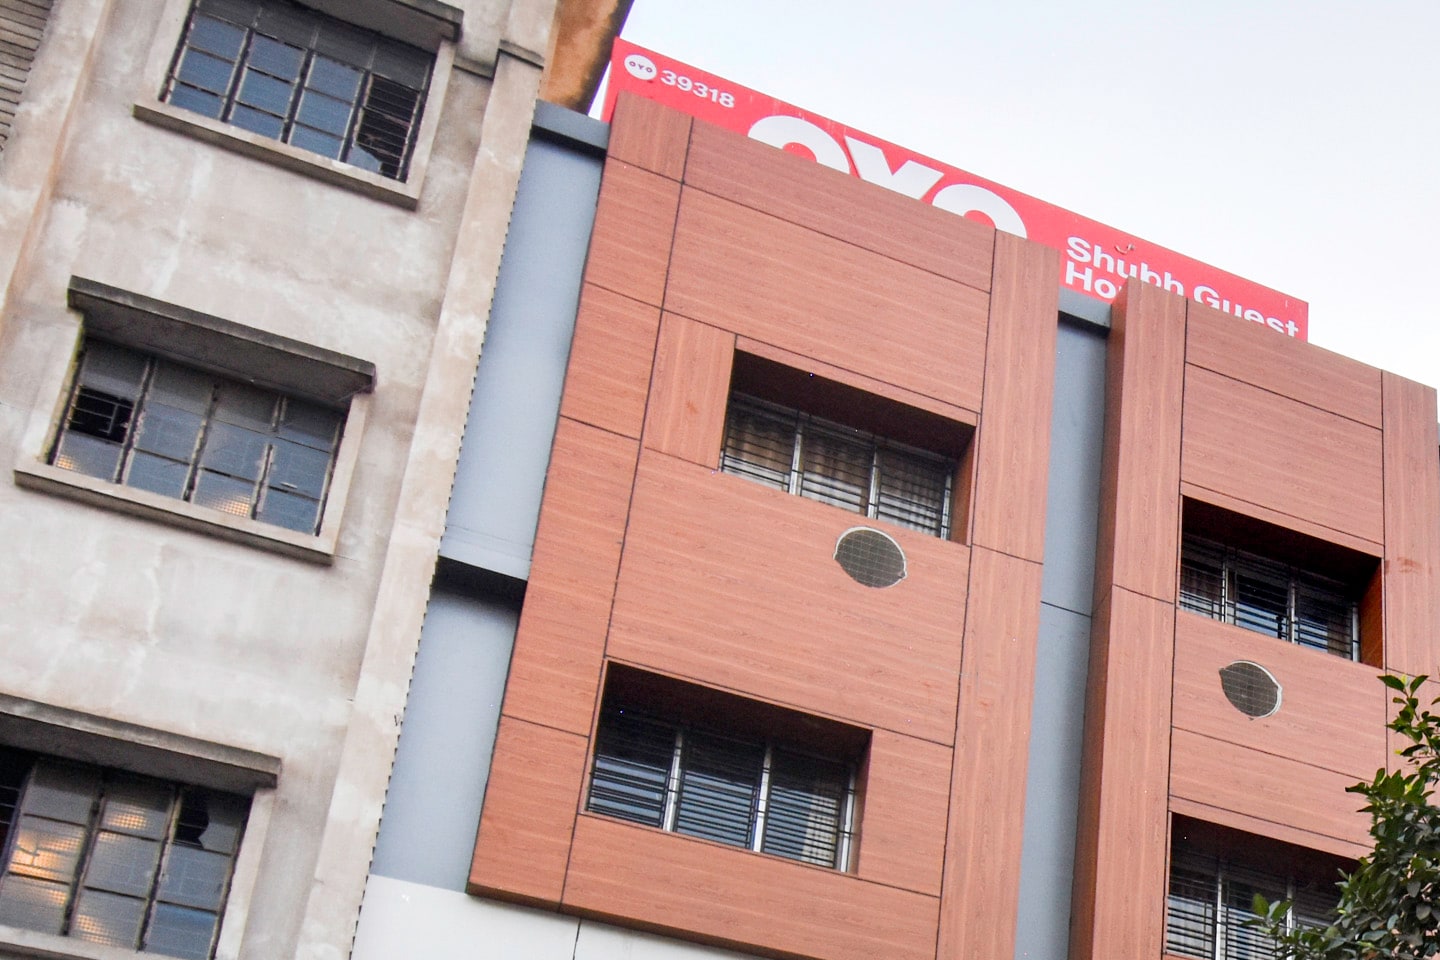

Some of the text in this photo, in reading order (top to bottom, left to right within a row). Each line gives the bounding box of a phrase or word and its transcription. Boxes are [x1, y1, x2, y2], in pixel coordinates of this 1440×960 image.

[628, 61, 735, 109] OYO 39318
[1066, 236, 1184, 297] Shubh
